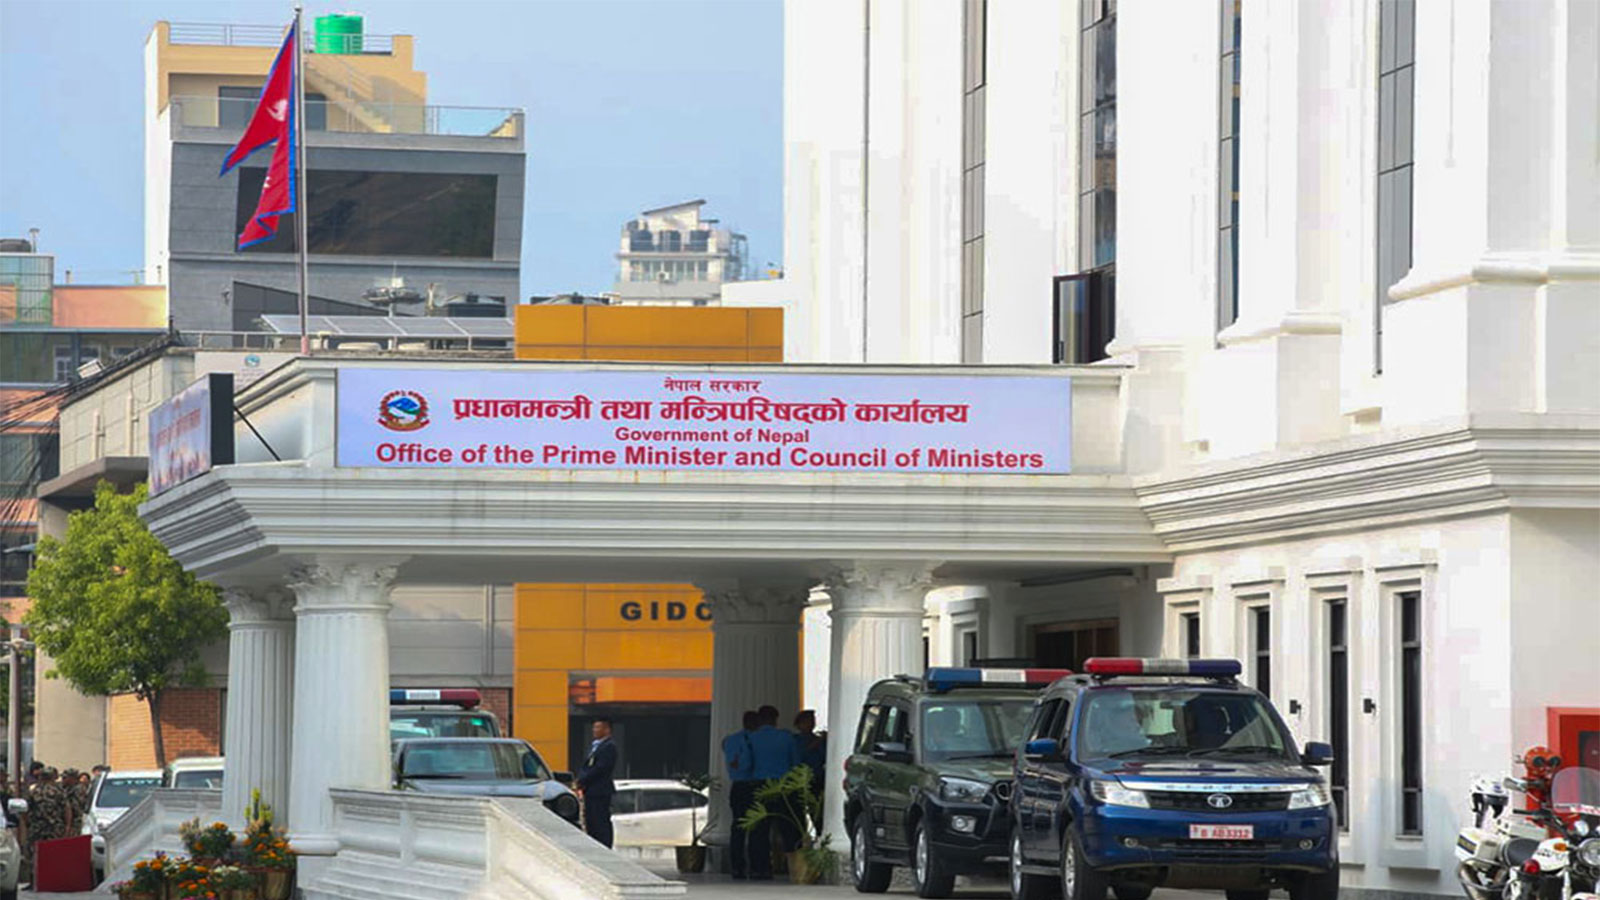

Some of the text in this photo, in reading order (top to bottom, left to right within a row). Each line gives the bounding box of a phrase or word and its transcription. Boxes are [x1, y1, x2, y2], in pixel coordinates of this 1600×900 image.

[664, 378, 761, 394] नेपाल सरकार
[453, 394, 592, 421] प्रधानमन्त्री
[600, 400, 652, 421] तथा
[855, 399, 970, 424] कार्यालय
[615, 427, 810, 446] Government of Nepal
[376, 443, 1044, 470] Office of the Prime Minister and Council of Ministers
